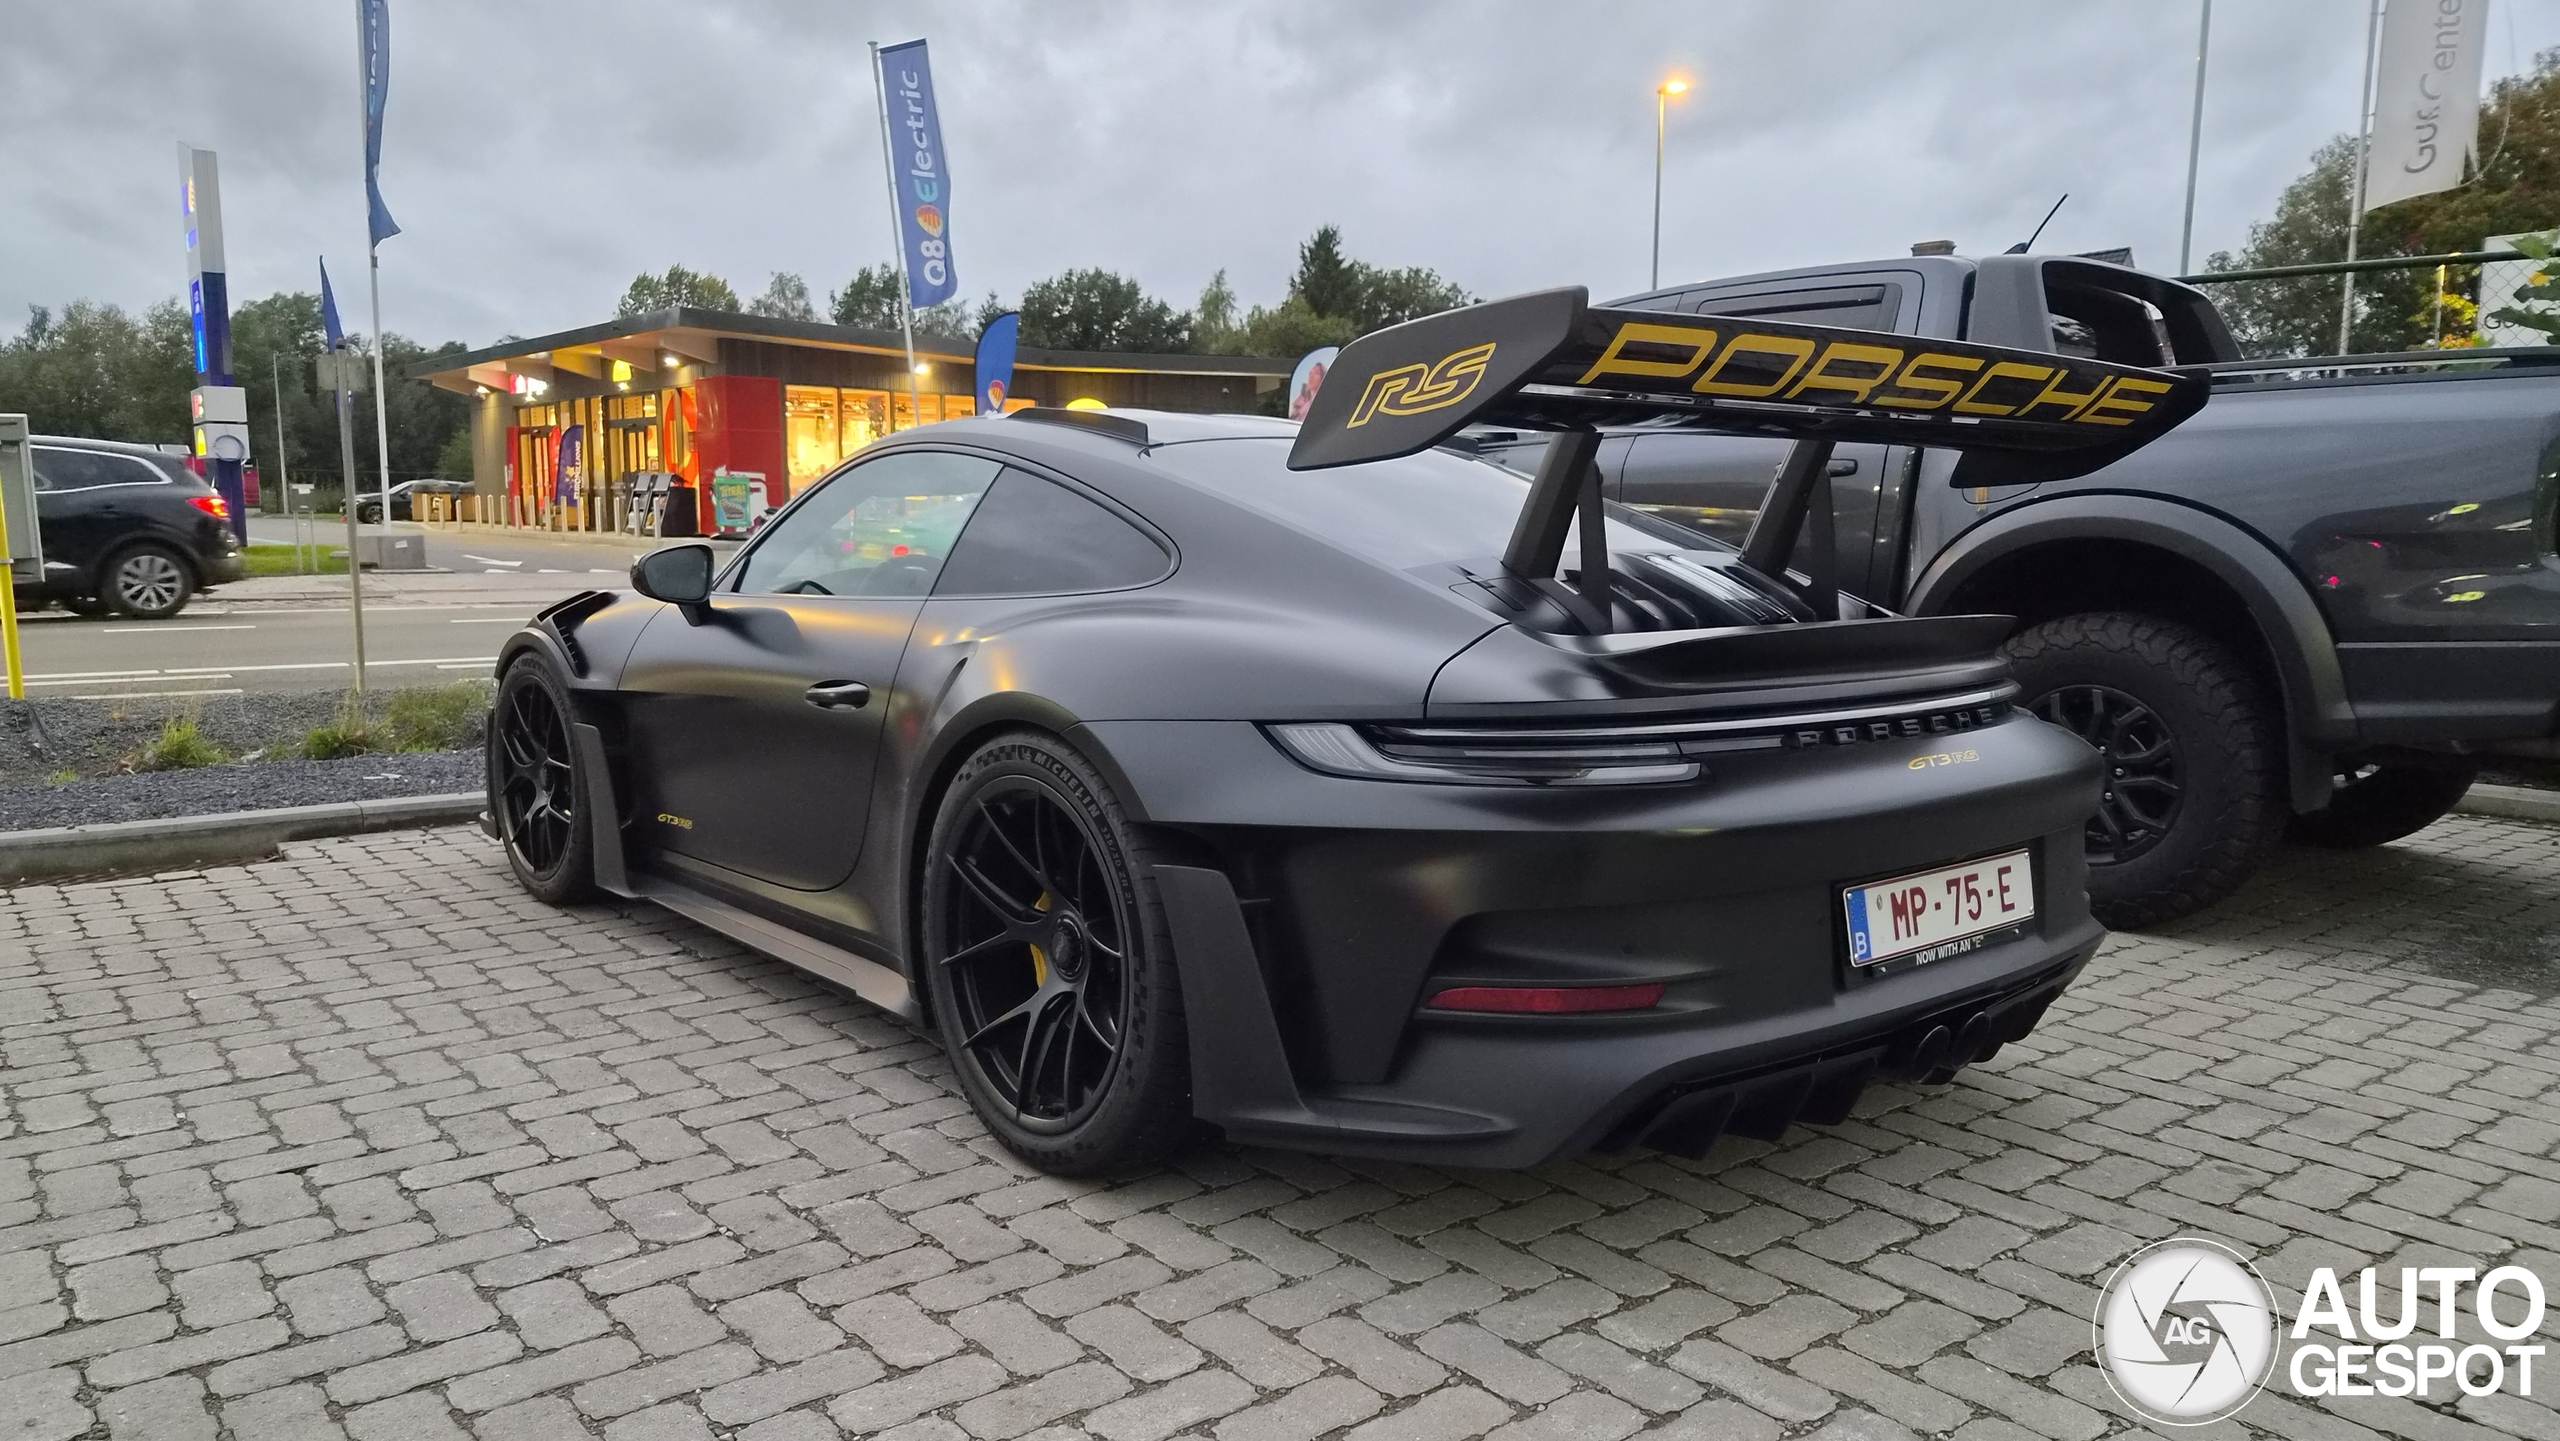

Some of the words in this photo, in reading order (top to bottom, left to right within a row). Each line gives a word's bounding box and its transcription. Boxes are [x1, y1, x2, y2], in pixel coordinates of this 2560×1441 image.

[900, 70, 939, 203] Electric
[920, 240, 947, 286] Q8
[1346, 342, 1497, 429] RS
[1576, 323, 2174, 426] PORSCHE
[1797, 708, 1993, 748] PORSCHE
[1034, 752, 1101, 819] MICHELIN
[1855, 931, 1867, 955] B
[1916, 950, 1936, 965] NOW
[1937, 944, 1959, 960] WITH
[1959, 940, 1971, 954] AN
